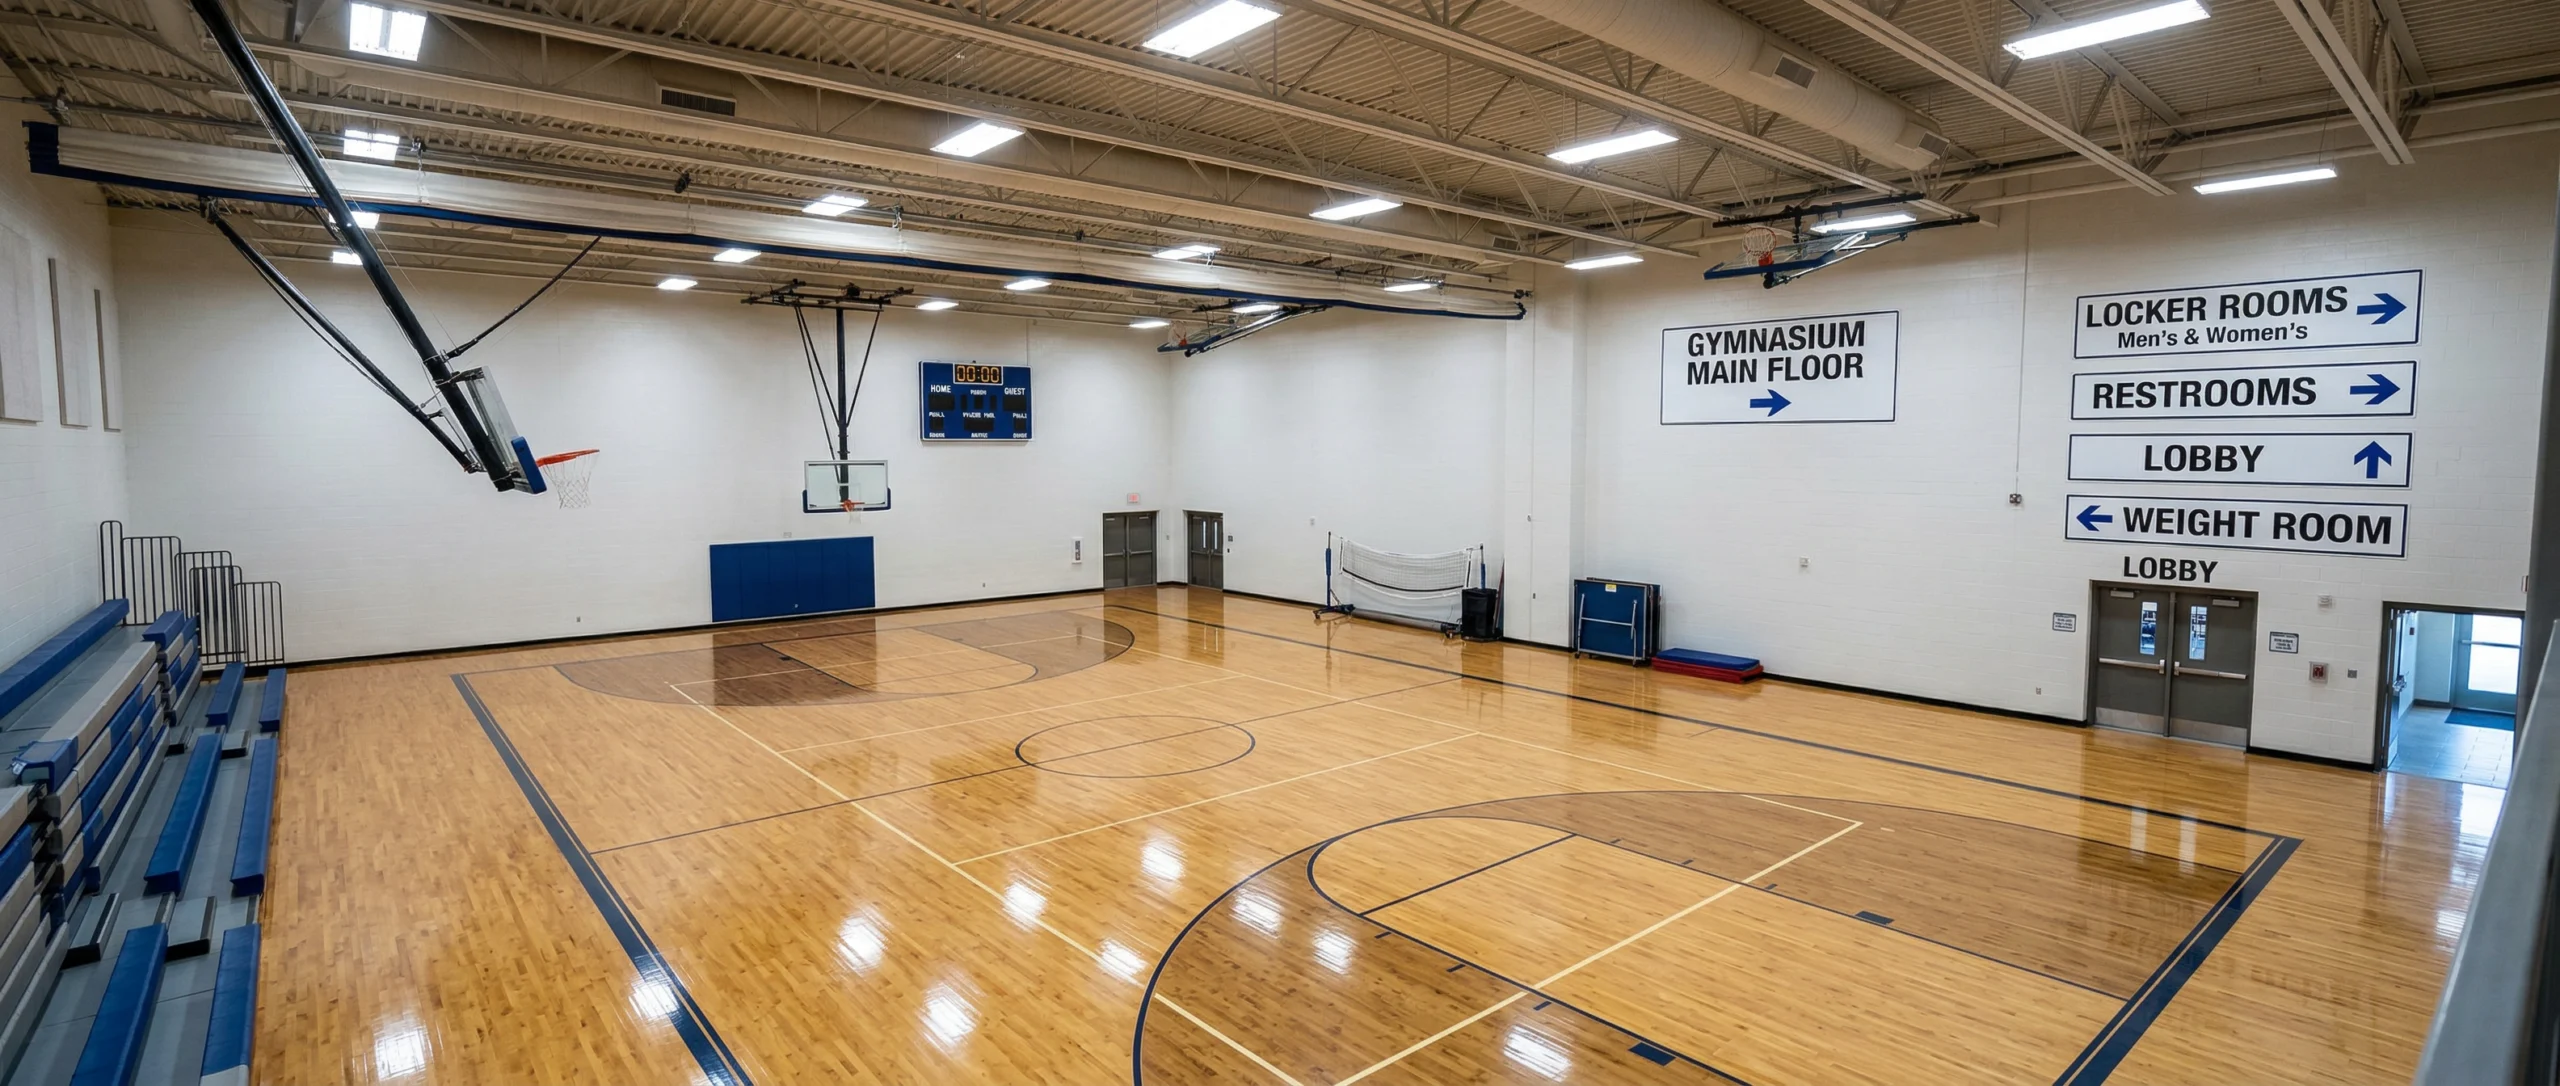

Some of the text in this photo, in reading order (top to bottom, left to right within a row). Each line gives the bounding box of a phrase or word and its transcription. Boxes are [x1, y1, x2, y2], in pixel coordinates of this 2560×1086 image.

[2086, 285, 2348, 327] LOCKER ROOMS
[1688, 320, 1865, 357] GYMNASIUM
[2118, 323, 2308, 348] Men's & Women's
[956, 365, 1000, 383] 00:00
[1688, 353, 1863, 385] MAIN FLOOR
[930, 384, 952, 393] HOME
[2093, 377, 2316, 408] RESTROOMS
[2144, 445, 2264, 472] LOBBY
[2124, 507, 2392, 544] WEIGHT ROOM
[2123, 556, 2218, 583] LOBBY
